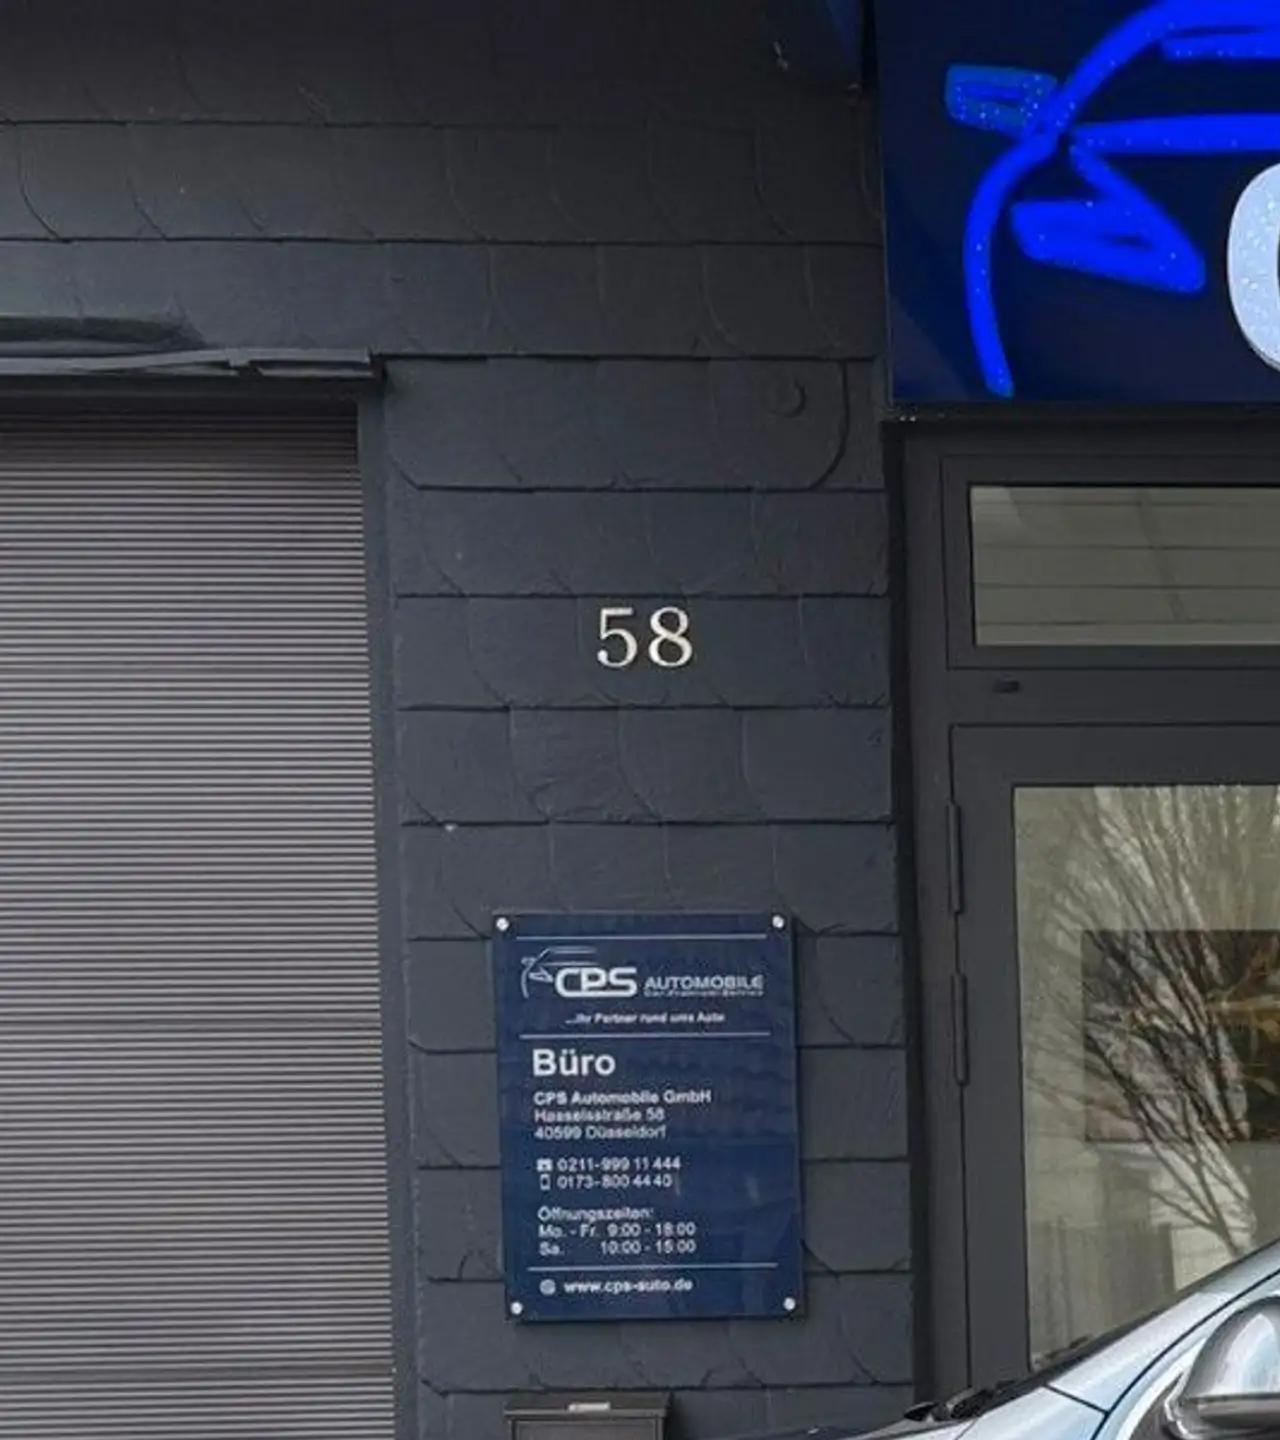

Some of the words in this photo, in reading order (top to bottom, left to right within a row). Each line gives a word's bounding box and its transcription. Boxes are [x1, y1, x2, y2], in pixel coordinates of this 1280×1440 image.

[596, 605, 693, 668] 58
[554, 966, 638, 998] CPS
[643, 974, 764, 991] AUTOMOBILE
[532, 1047, 616, 1077] Büro
[533, 1090, 568, 1106] CPS
[571, 1089, 660, 1104] Automobile
[663, 1088, 712, 1104] GmbH
[534, 1125, 582, 1140] 40599
[585, 1124, 667, 1140] Düsseldorf
[563, 1278, 693, 1294] www.cps-auto.de
